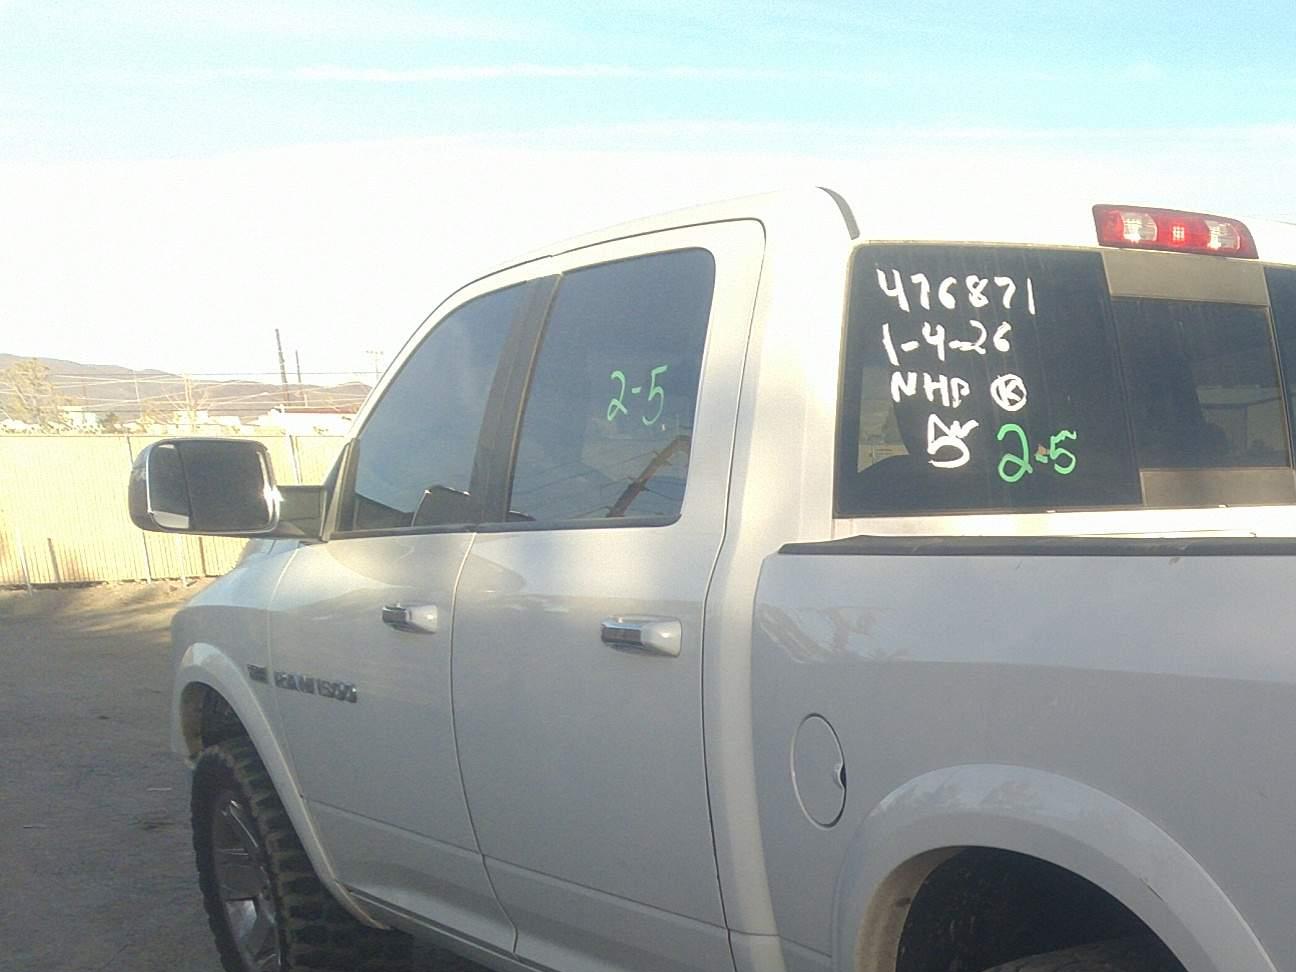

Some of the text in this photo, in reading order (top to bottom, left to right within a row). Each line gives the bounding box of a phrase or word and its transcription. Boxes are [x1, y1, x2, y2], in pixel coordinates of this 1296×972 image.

[877, 269, 1035, 315] 476871
[882, 320, 1012, 366] 1-4-26
[607, 364, 668, 425] 2-5
